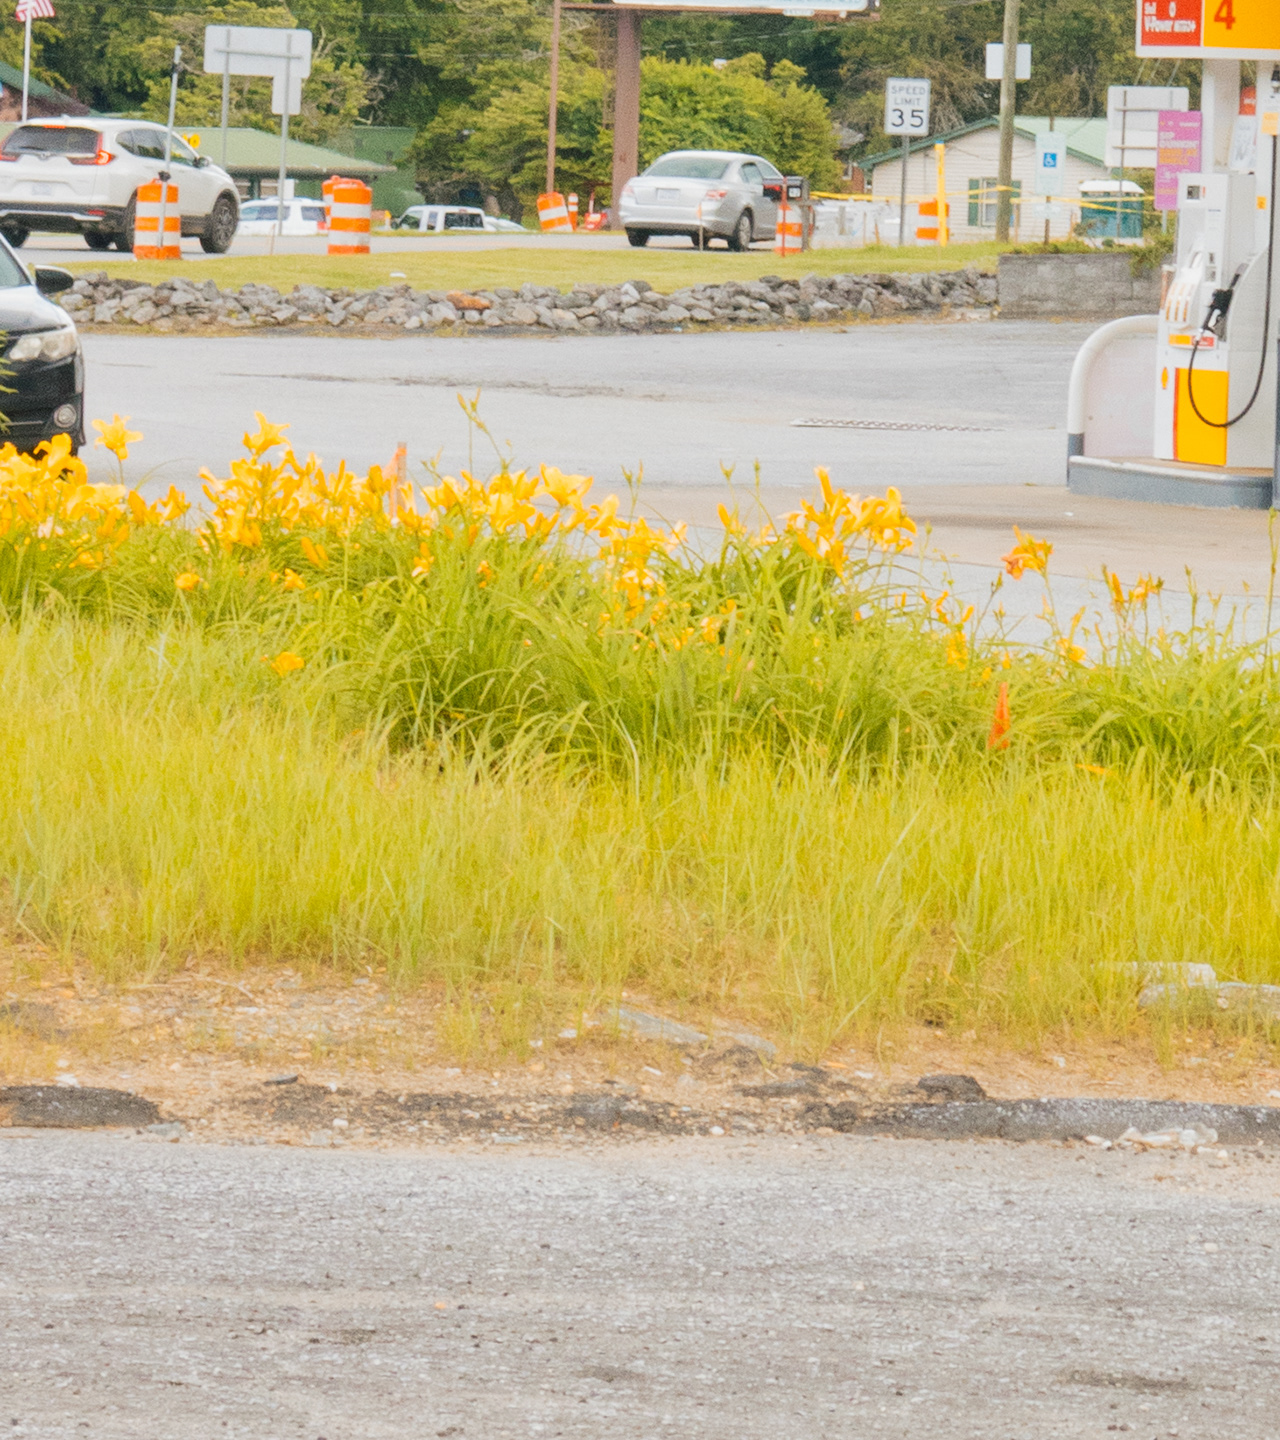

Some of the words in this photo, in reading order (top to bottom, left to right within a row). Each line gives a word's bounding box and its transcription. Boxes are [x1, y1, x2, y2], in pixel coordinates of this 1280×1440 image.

[891, 85, 926, 95] SPEED
[894, 97, 921, 106] LIMIT
[891, 108, 924, 128] 35
